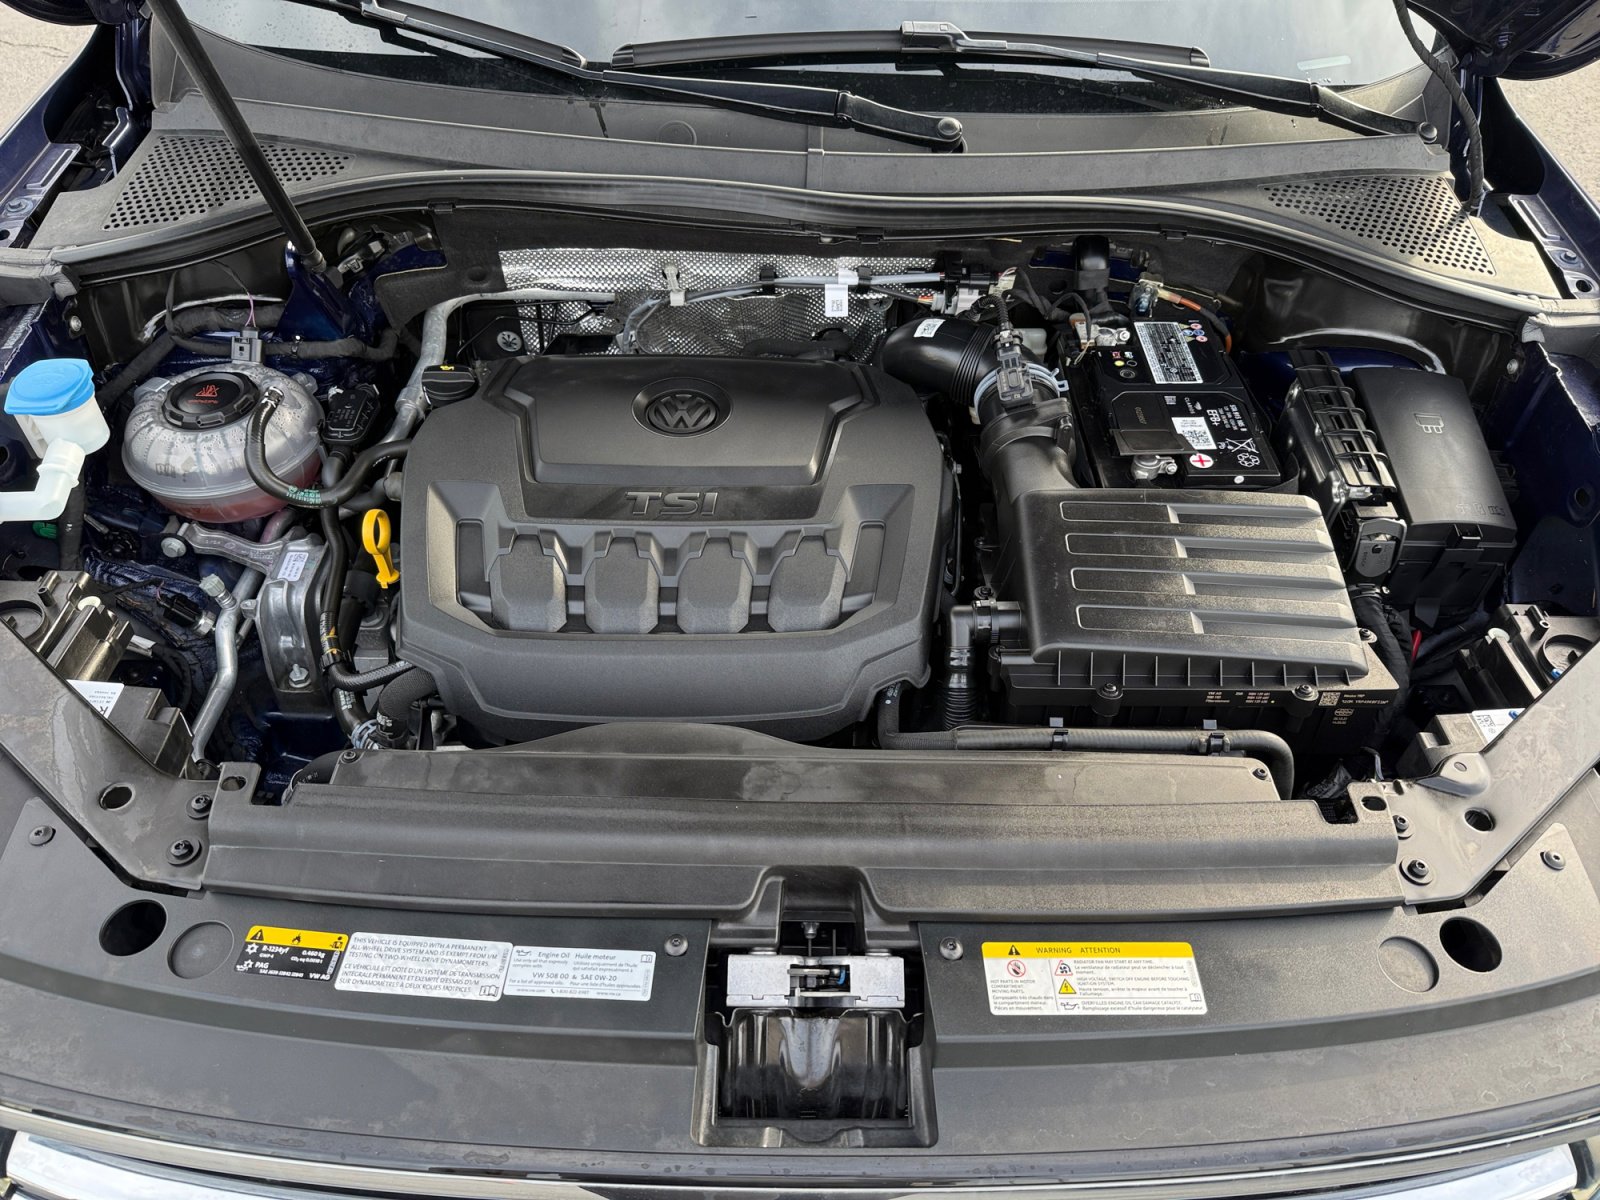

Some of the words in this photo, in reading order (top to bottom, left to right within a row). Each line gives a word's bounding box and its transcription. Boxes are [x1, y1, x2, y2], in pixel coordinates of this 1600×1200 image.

[1206, 410, 1221, 426] EFB+
[625, 491, 718, 516] TSI
[262, 945, 290, 954] R-1234yf
[458, 971, 500, 980] TRANSMISSION
